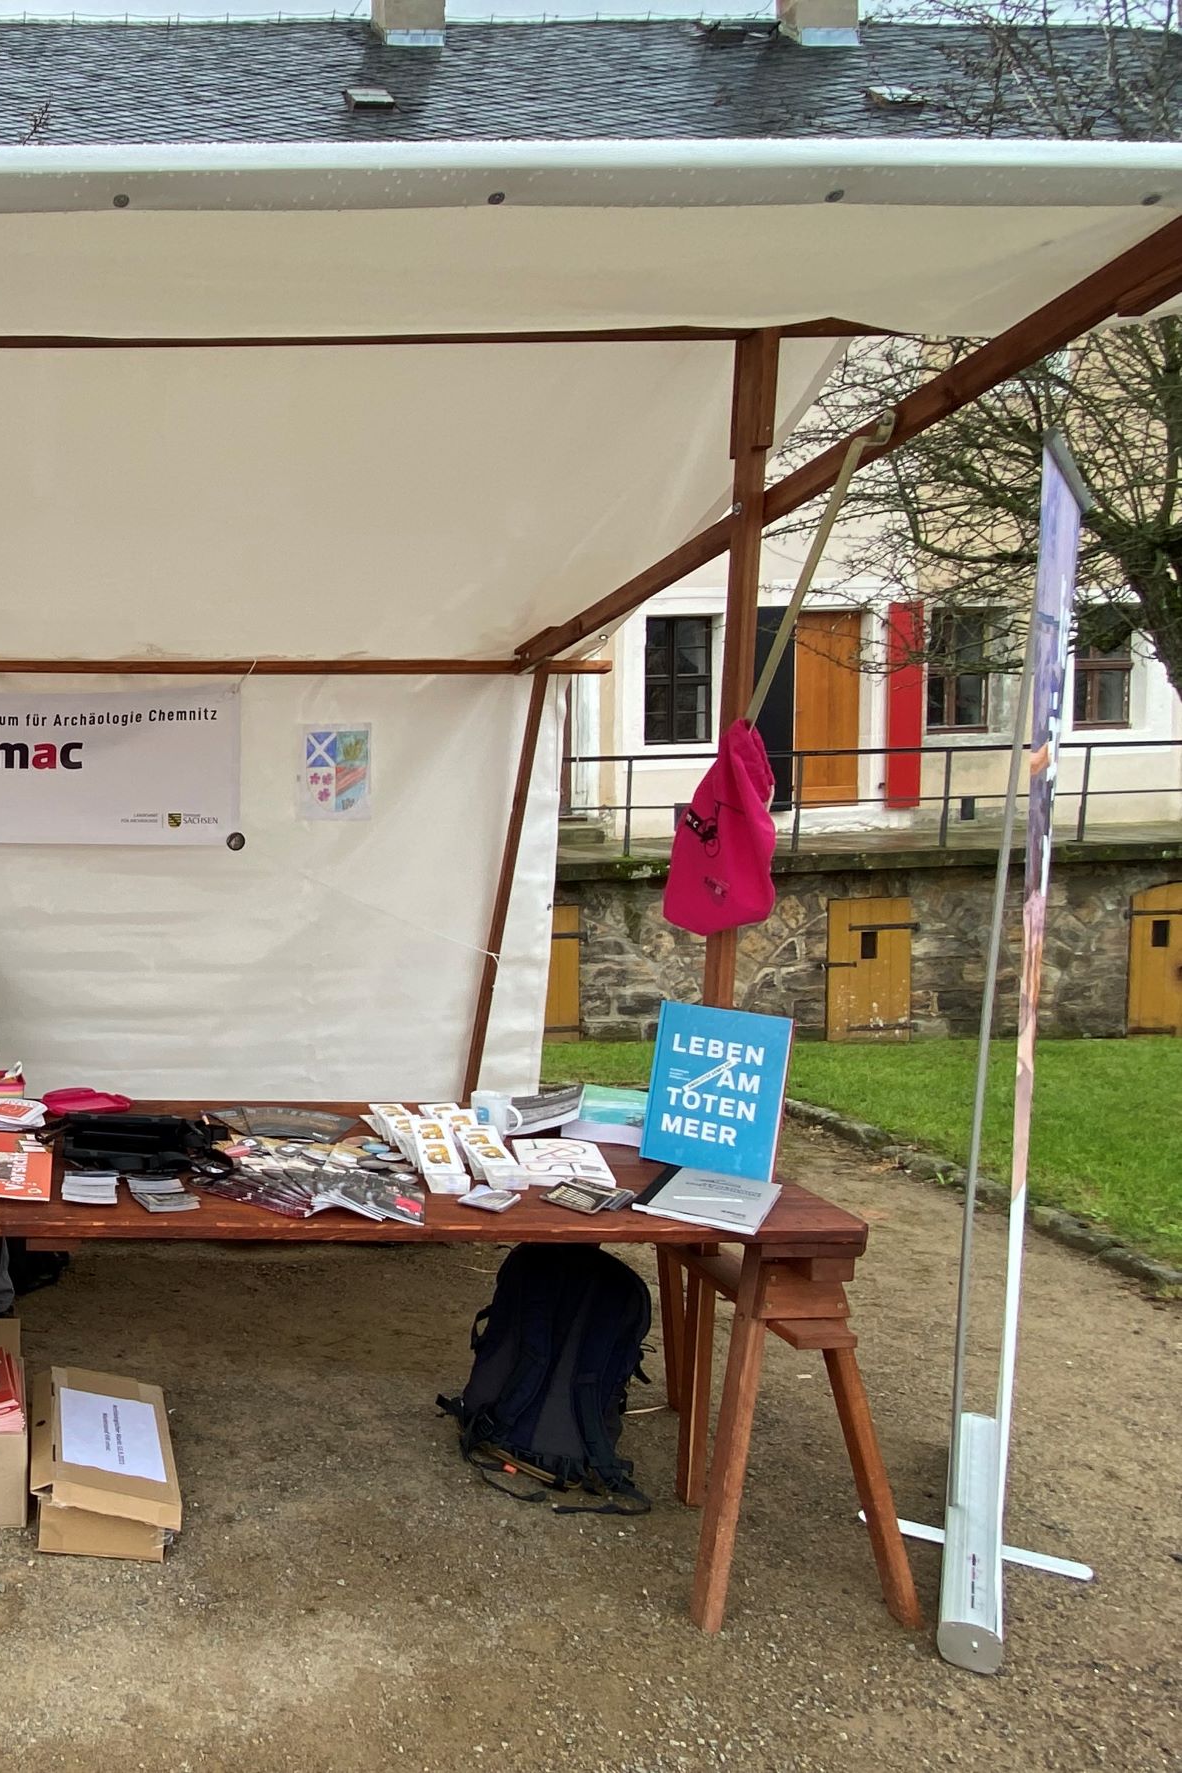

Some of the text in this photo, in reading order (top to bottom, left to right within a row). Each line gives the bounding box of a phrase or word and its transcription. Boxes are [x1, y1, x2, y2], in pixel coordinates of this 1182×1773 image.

[26, 714, 47, 727] für
[53, 712, 143, 727] Archäologie
[148, 707, 218, 722] Chemnitz
[183, 816, 219, 825] SACHSEN
[672, 1033, 765, 1067] LEBEN
[716, 1070, 762, 1094] AM
[666, 1087, 757, 1122] TOTEN
[660, 1113, 738, 1147] MEER
